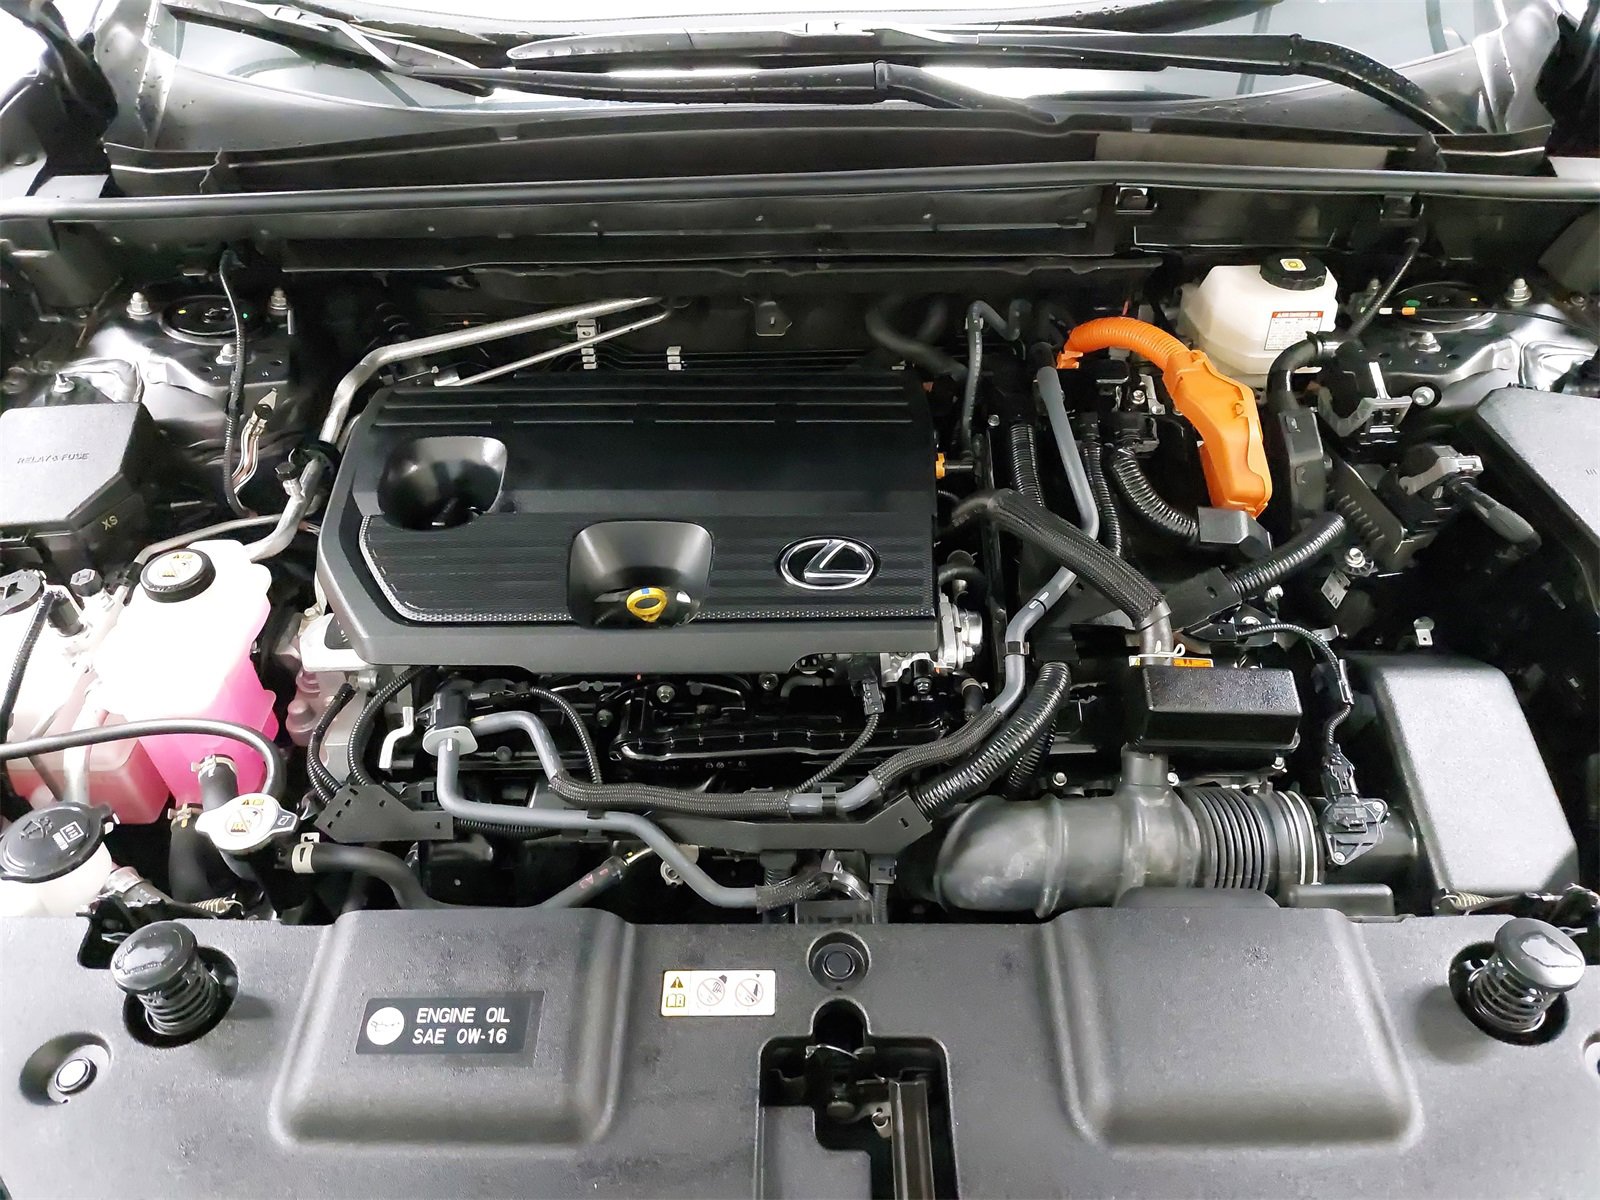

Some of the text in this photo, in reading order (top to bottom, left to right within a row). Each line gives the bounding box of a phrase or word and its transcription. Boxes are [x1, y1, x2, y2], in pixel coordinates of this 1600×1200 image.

[17, 455, 51, 464] RELAY
[61, 452, 89, 461] FUSE
[416, 1007, 511, 1024] ENGINE OIL
[412, 1028, 508, 1045] SAE 0W-16
